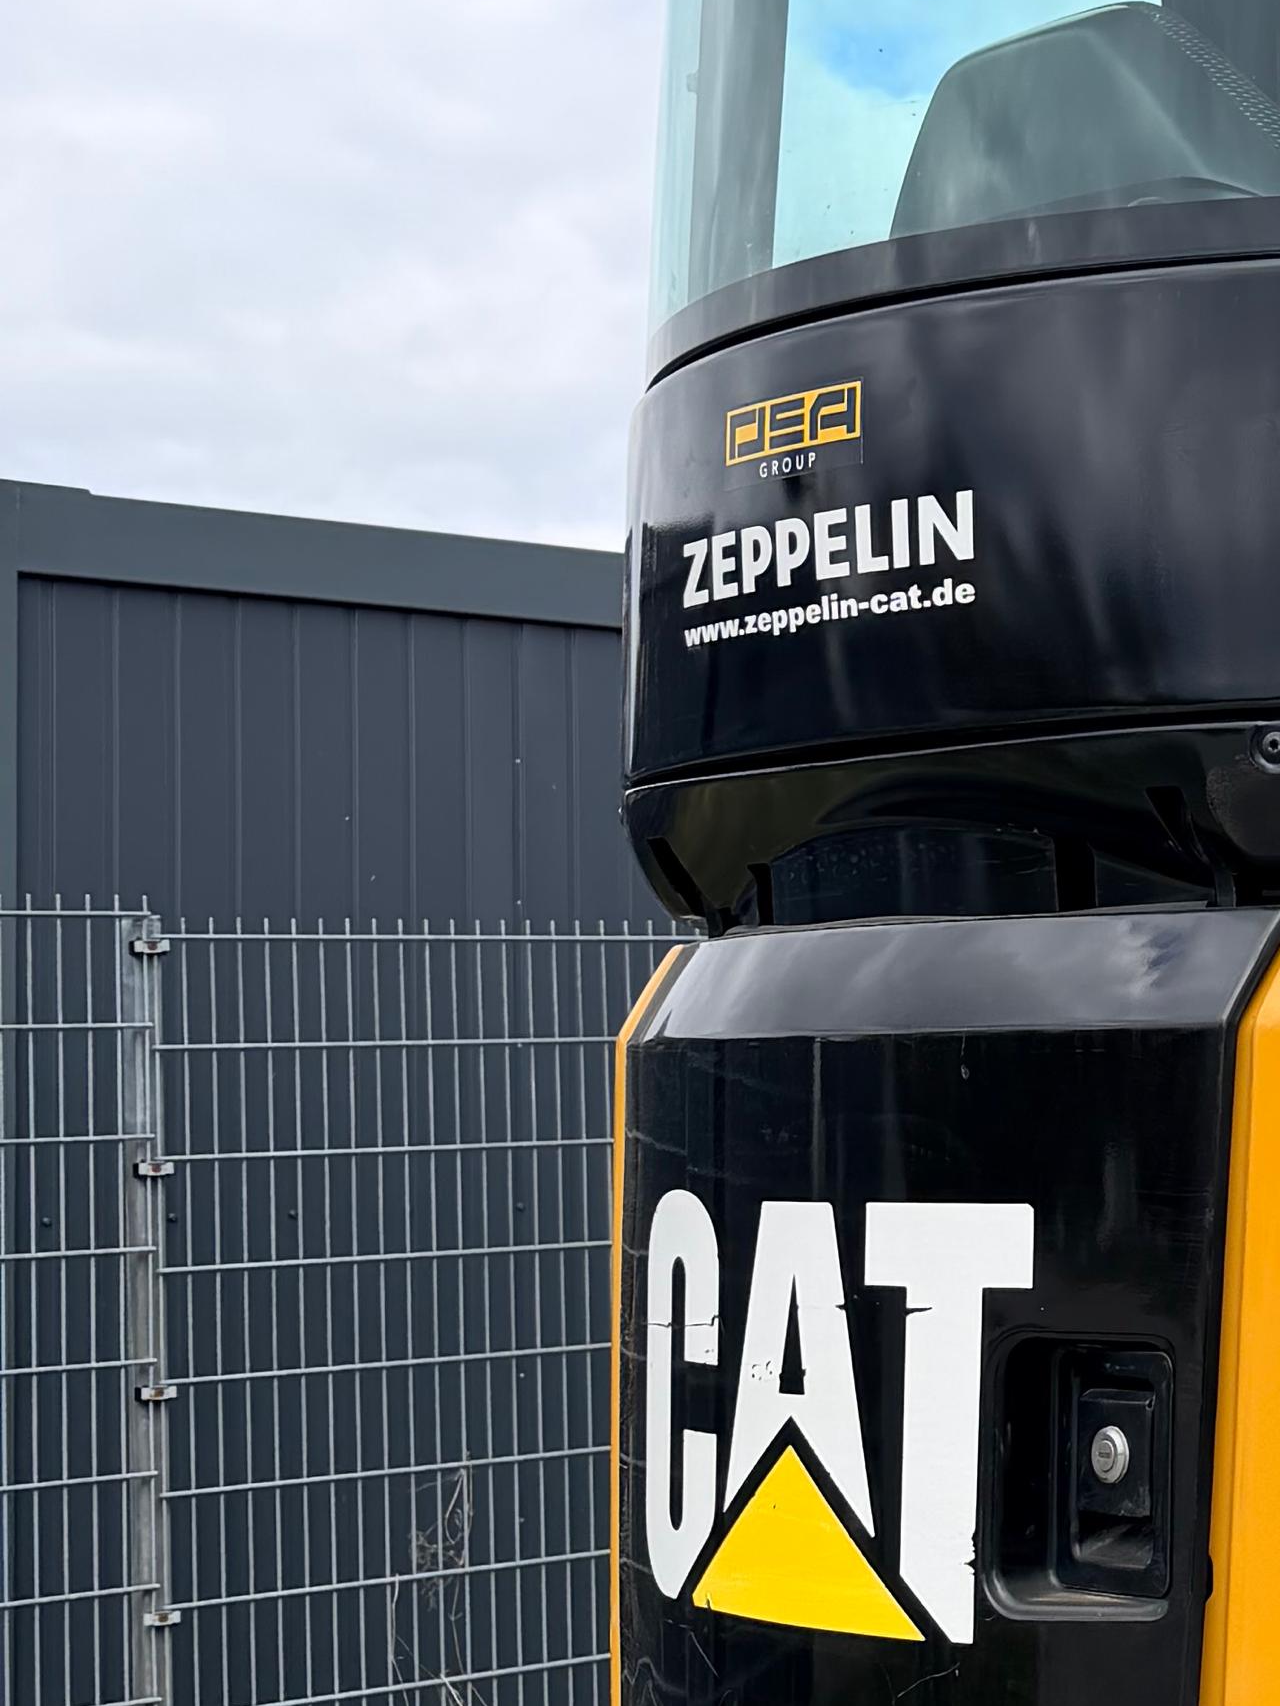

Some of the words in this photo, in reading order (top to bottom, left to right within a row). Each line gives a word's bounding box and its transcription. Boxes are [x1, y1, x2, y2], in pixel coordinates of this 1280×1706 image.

[758, 451, 817, 479] GROUP
[682, 489, 975, 610] ZEPPELIN
[683, 577, 976, 647] www.zeppelin-cat.de
[644, 1187, 1036, 1646] CAT
